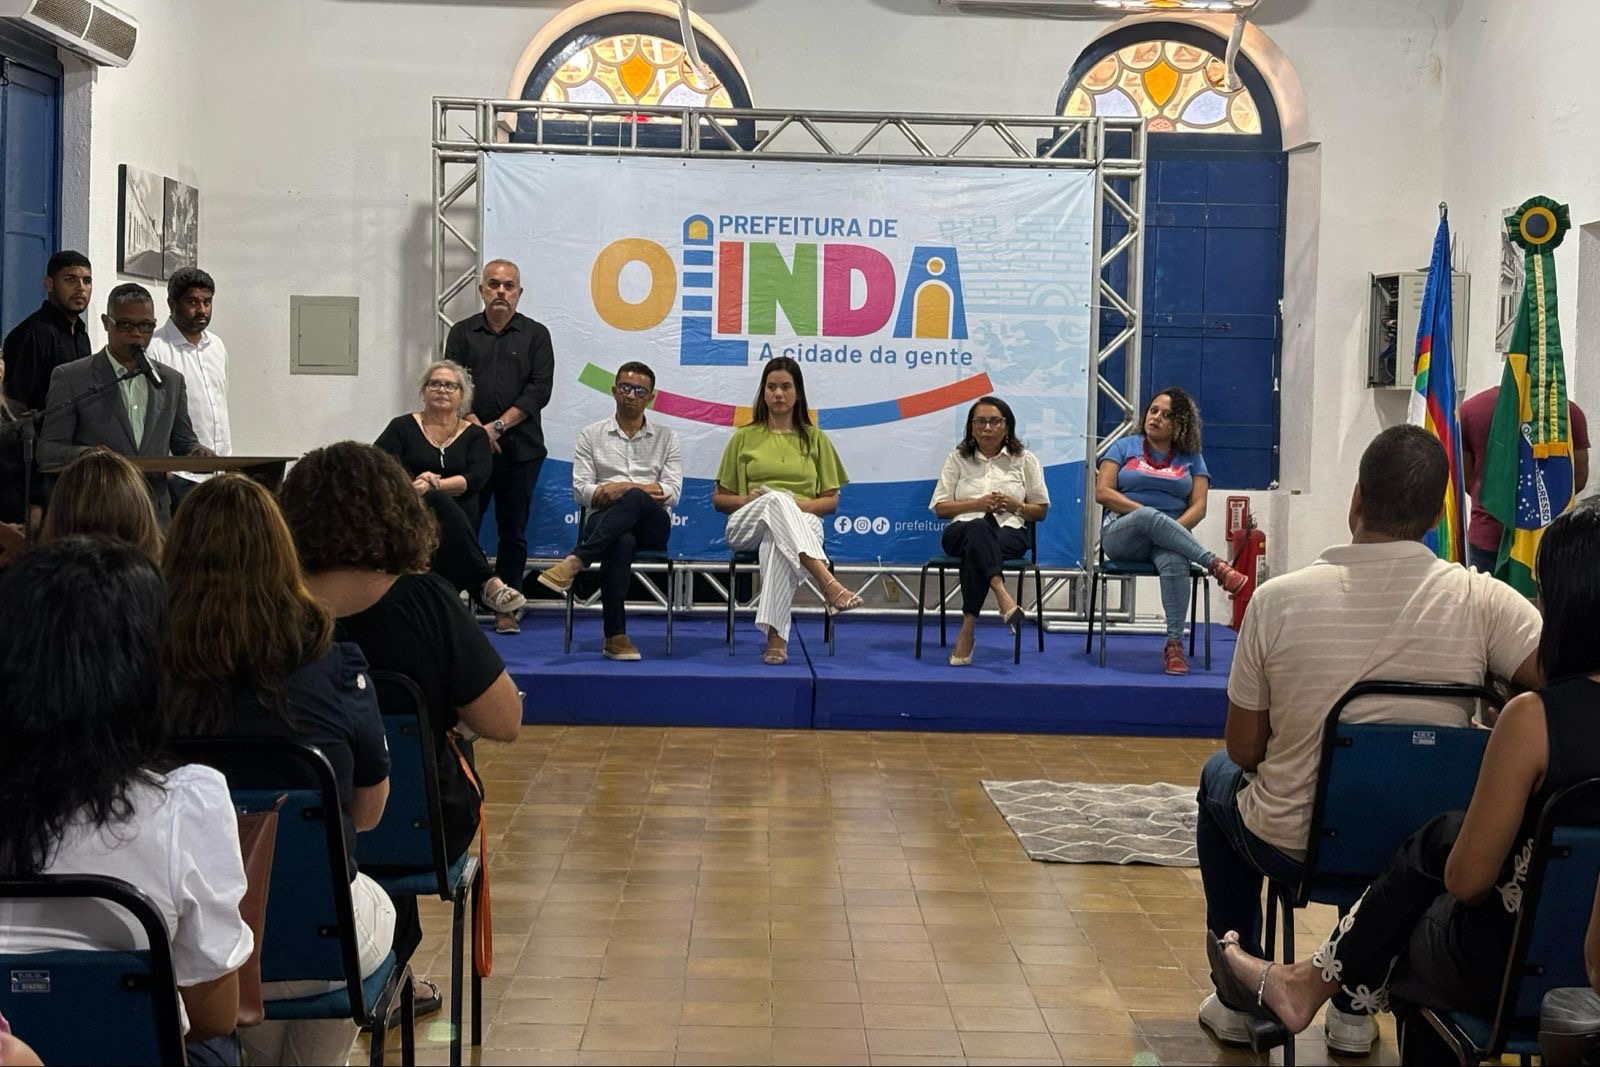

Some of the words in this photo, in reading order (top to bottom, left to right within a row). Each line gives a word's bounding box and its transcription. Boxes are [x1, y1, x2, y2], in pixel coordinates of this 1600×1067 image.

[719, 214, 864, 238] PREFEITURA
[868, 219, 898, 238] DE
[590, 213, 969, 366] OLINDA
[759, 343, 774, 361] A
[783, 343, 863, 364] cidade
[869, 345, 897, 365] da
[905, 348, 973, 369] gente
[894, 519, 949, 533] prefeitur
